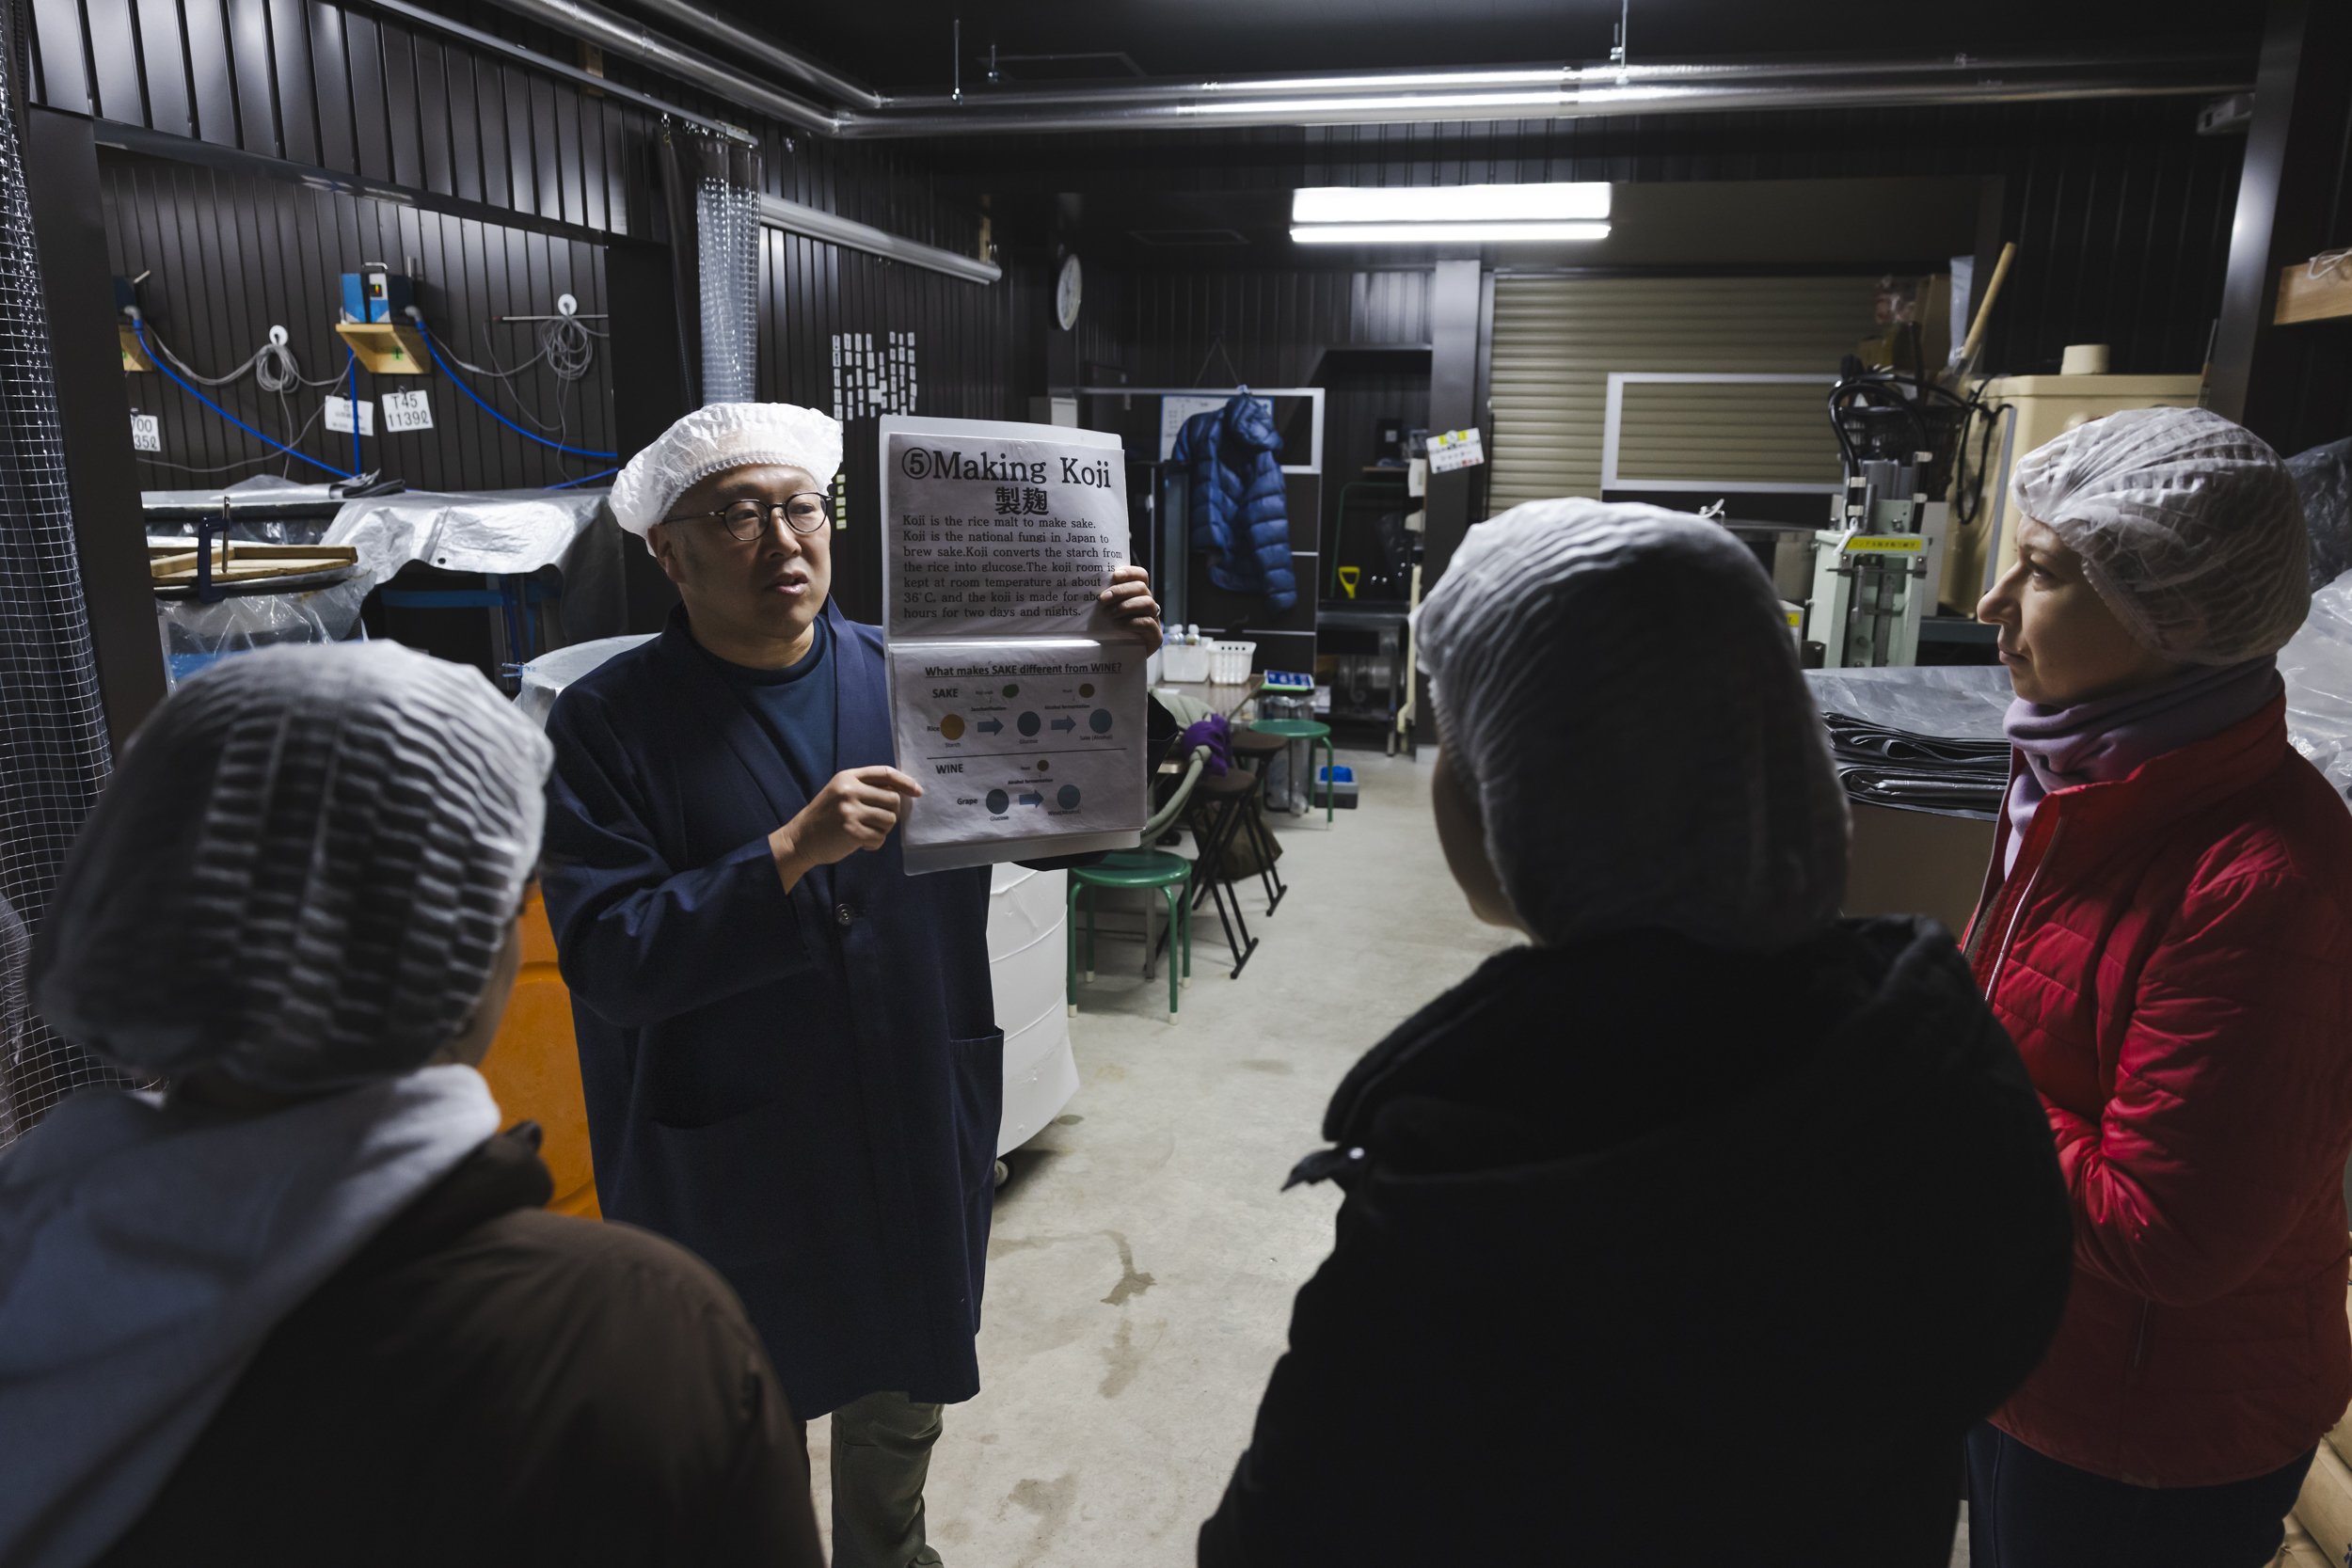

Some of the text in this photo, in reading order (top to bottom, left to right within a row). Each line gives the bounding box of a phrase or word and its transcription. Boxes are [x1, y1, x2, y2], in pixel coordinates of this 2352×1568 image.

[391, 393, 417, 408] T45
[1060, 457, 1111, 488] Koji
[995, 486, 1048, 515] 製麹
[903, 515, 1096, 529] Koji is the rice malt to make sake.
[903, 531, 1108, 544] Koji is the national fungi in Japan to
[903, 546, 931, 557] brew
[993, 547, 1040, 558] converts
[1045, 547, 1061, 558] the
[1067, 547, 1099, 559] starch
[1103, 548, 1122, 559] from
[903, 562, 922, 572] the
[928, 562, 949, 572] rice
[955, 562, 977, 572] into
[1052, 562, 1072, 574] koji
[1108, 562, 1115, 572] is
[903, 578, 1101, 589] kept at room temperature at about
[942, 592, 962, 602] and
[969, 592, 986, 602] the
[992, 592, 1010, 603] koji
[1016, 593, 1025, 602] is
[1029, 592, 1058, 602] made
[1063, 592, 1078, 602] for
[1084, 592, 1101, 602] abo
[903, 606, 1081, 619] hours for two days and nights.
[926, 662, 1121, 676] What makes SAKE different from WINE?
[932, 689, 958, 699] SAKE
[935, 764, 963, 774] WINE
[957, 798, 977, 806] Grape
